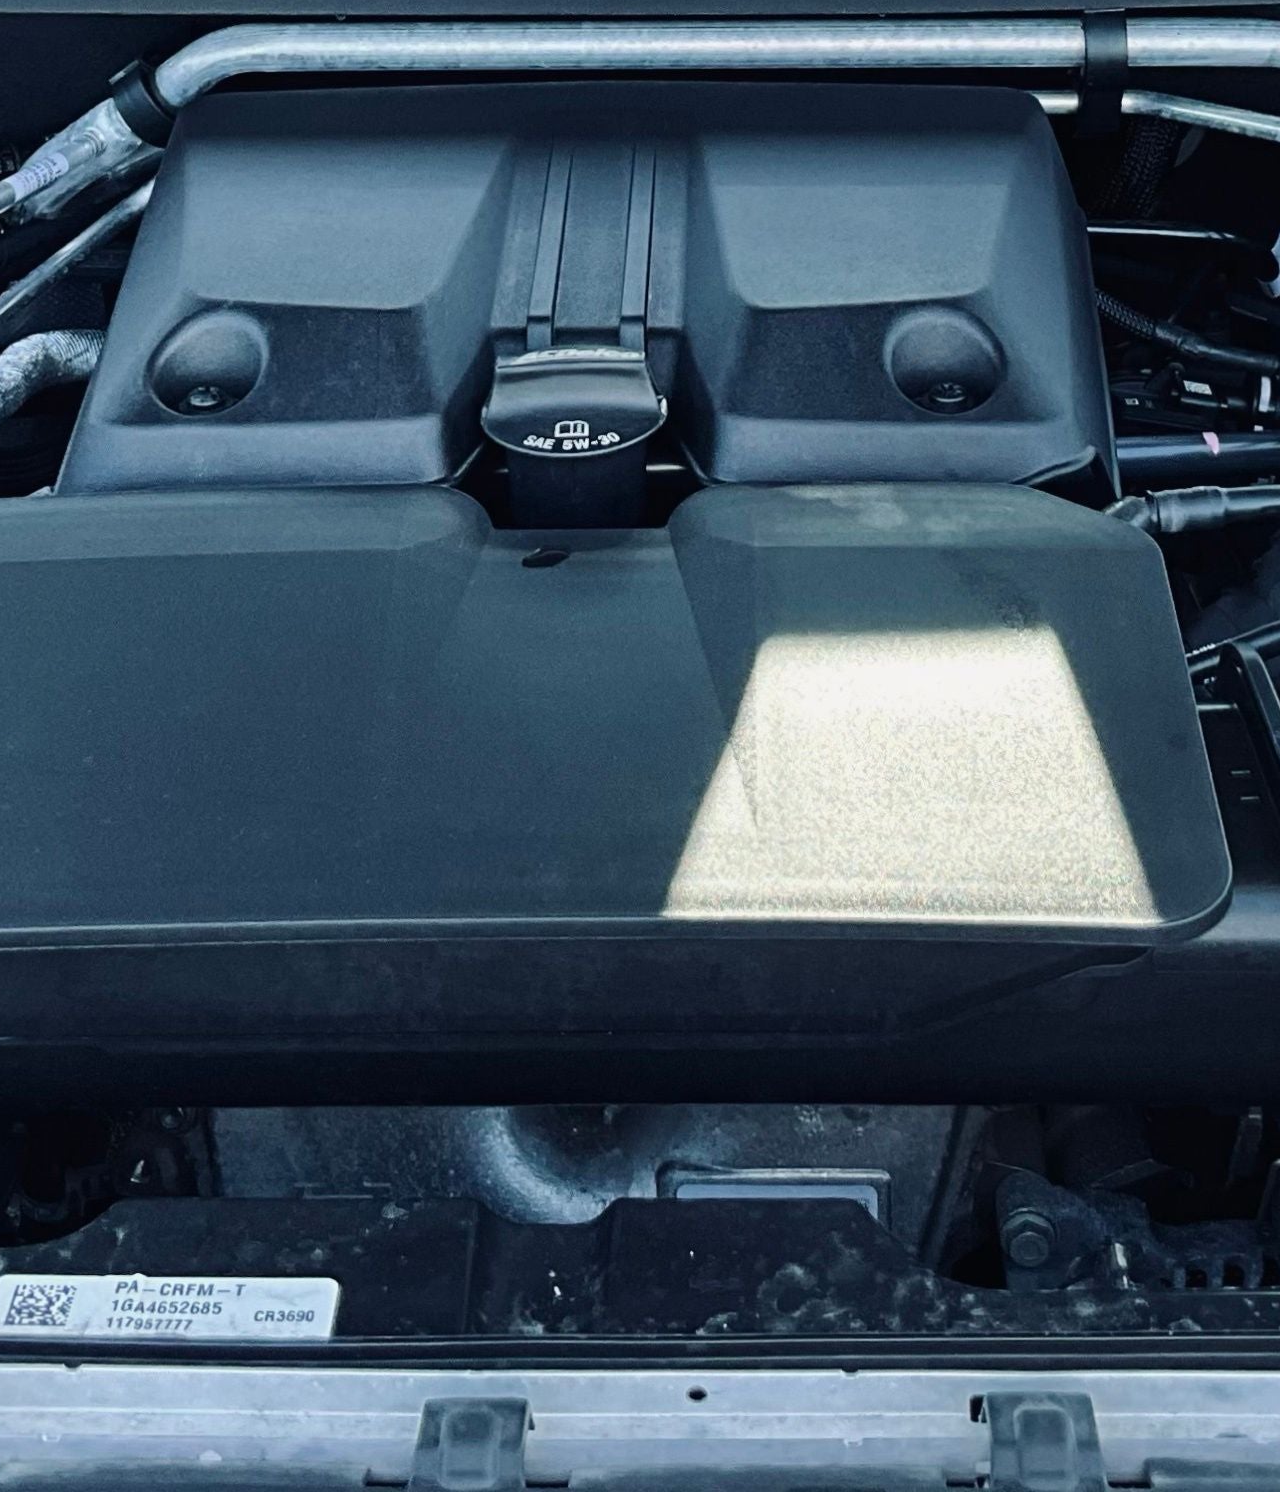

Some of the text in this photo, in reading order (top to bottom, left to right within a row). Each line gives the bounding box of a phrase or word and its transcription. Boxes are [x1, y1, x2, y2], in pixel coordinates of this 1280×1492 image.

[523, 432, 621, 451] SAE 5W-30
[111, 1299, 223, 1315] 1GA4652685
[254, 1310, 315, 1323] CR3690
